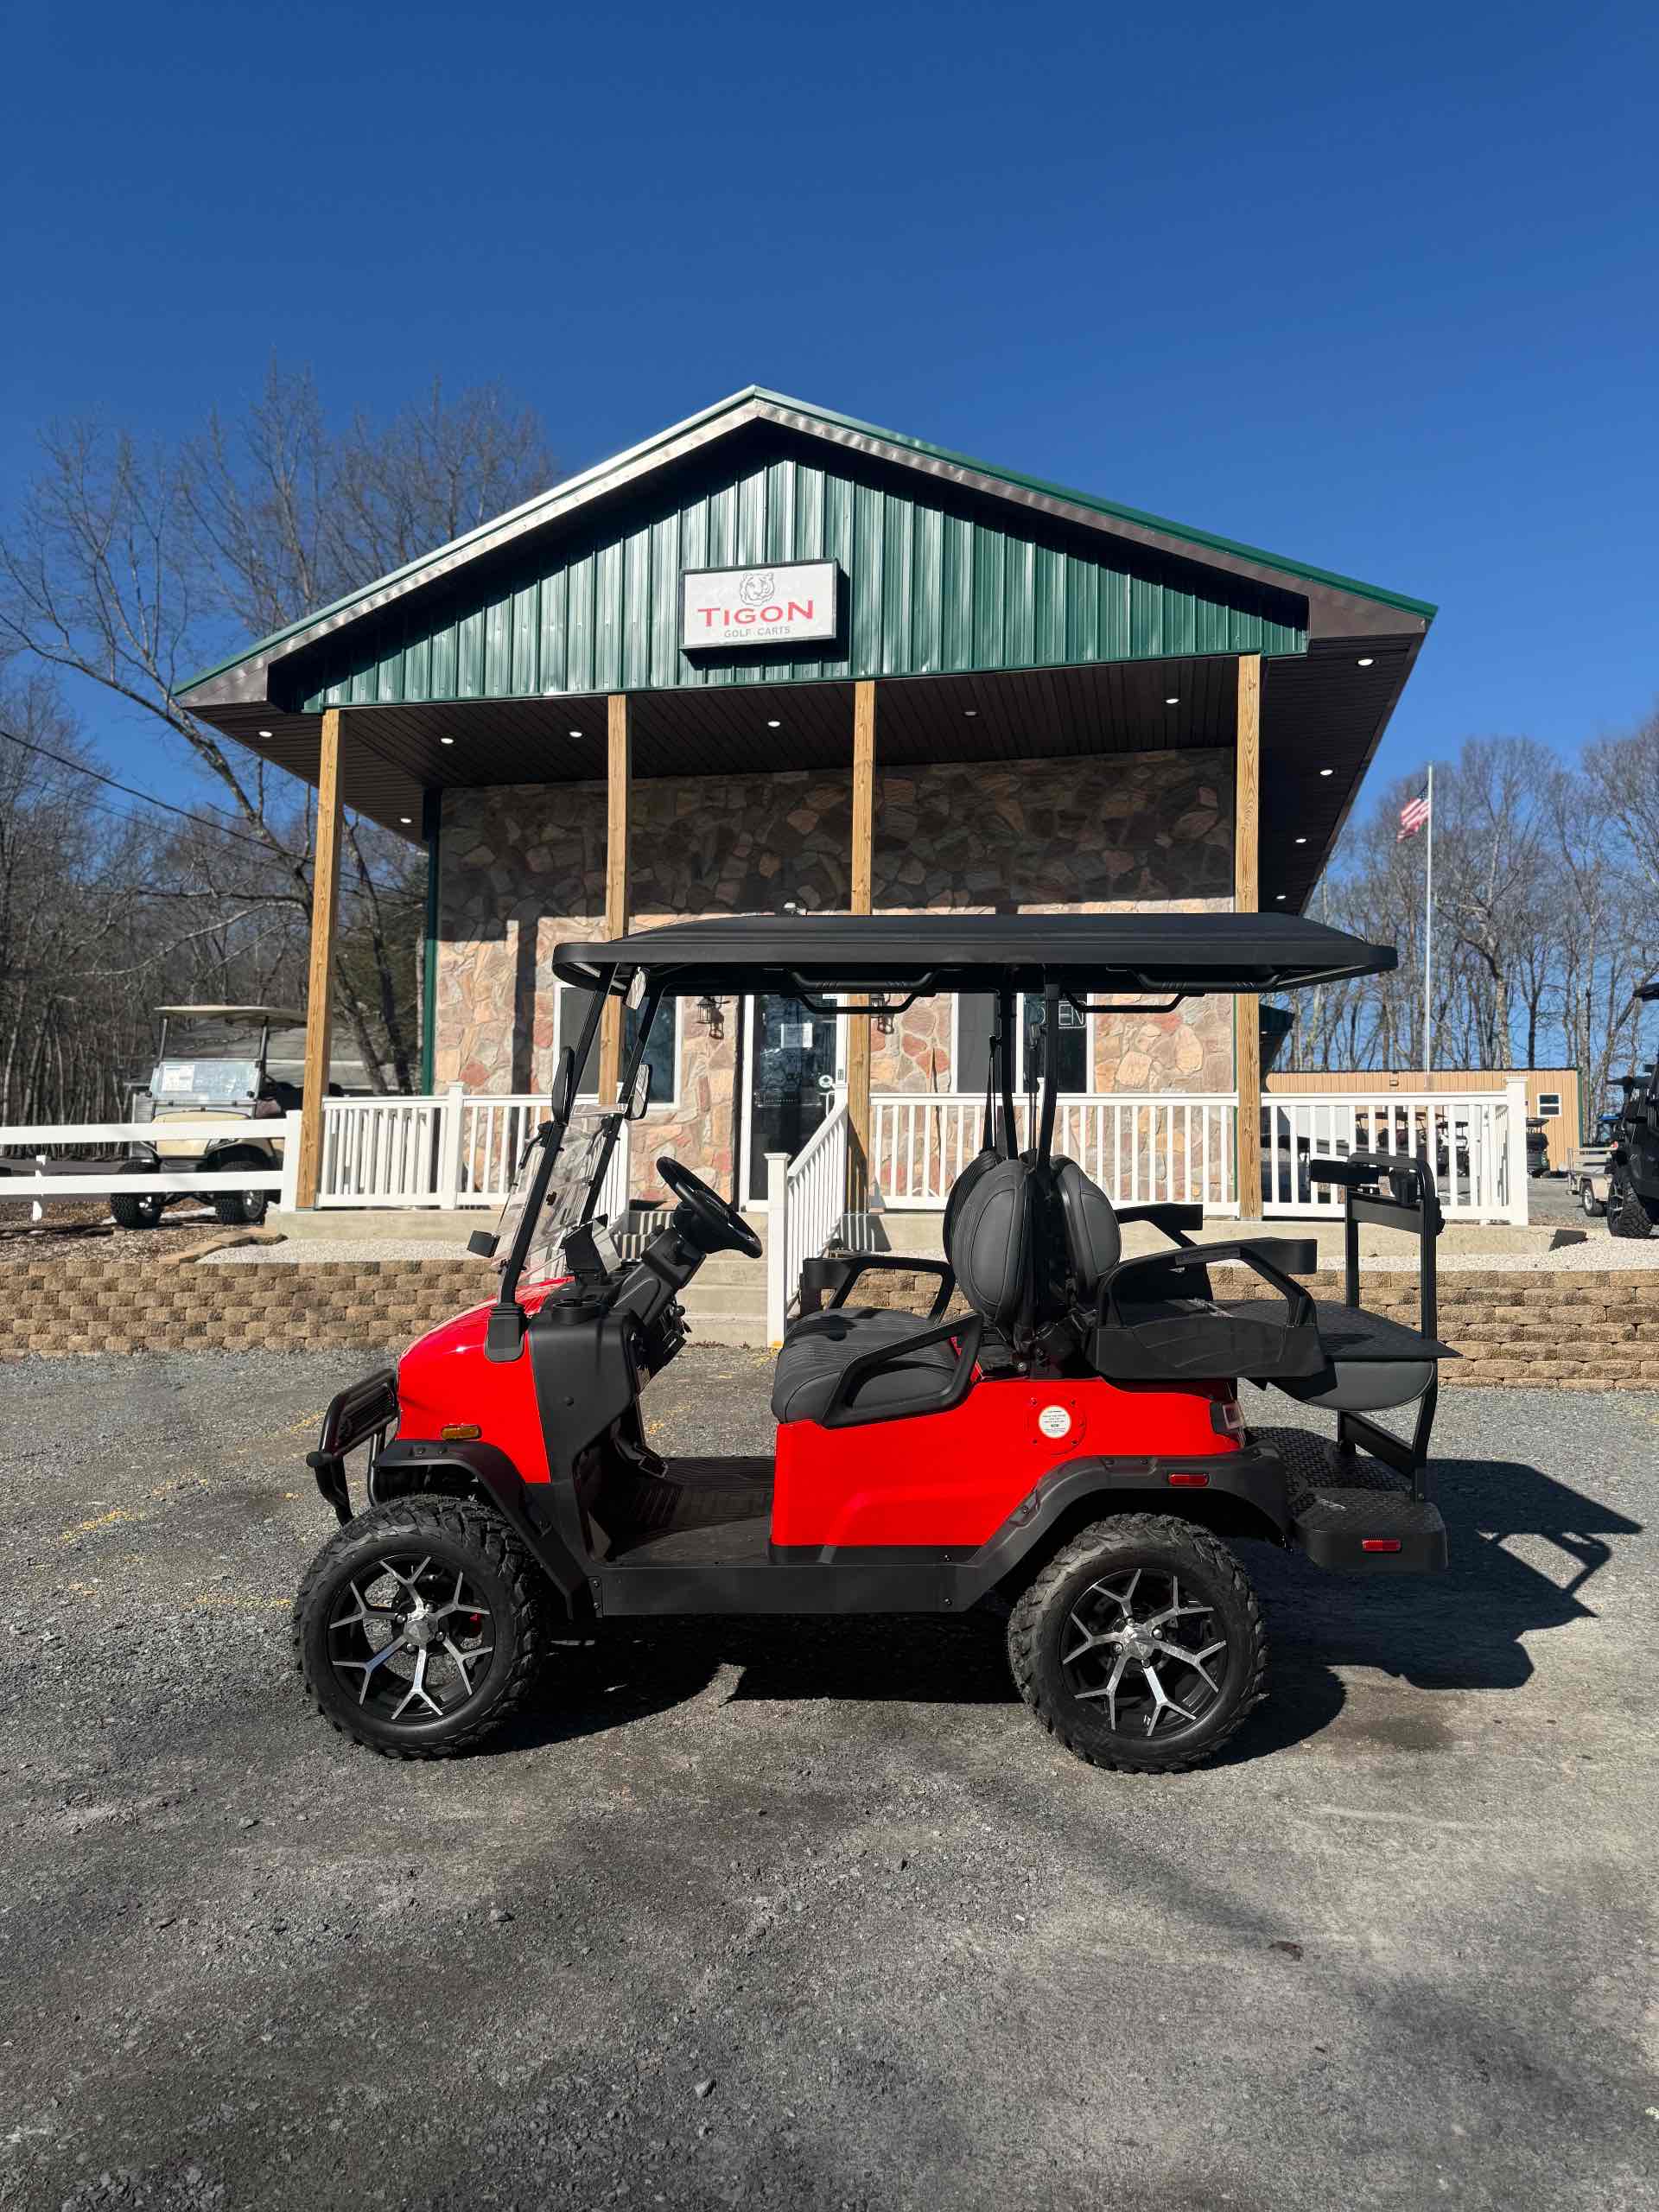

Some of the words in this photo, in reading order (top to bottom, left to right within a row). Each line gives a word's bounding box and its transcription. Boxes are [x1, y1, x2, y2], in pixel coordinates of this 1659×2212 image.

[697, 600, 814, 627] TIGON
[724, 628, 750, 639] GOLF
[757, 626, 791, 636] CARTS
